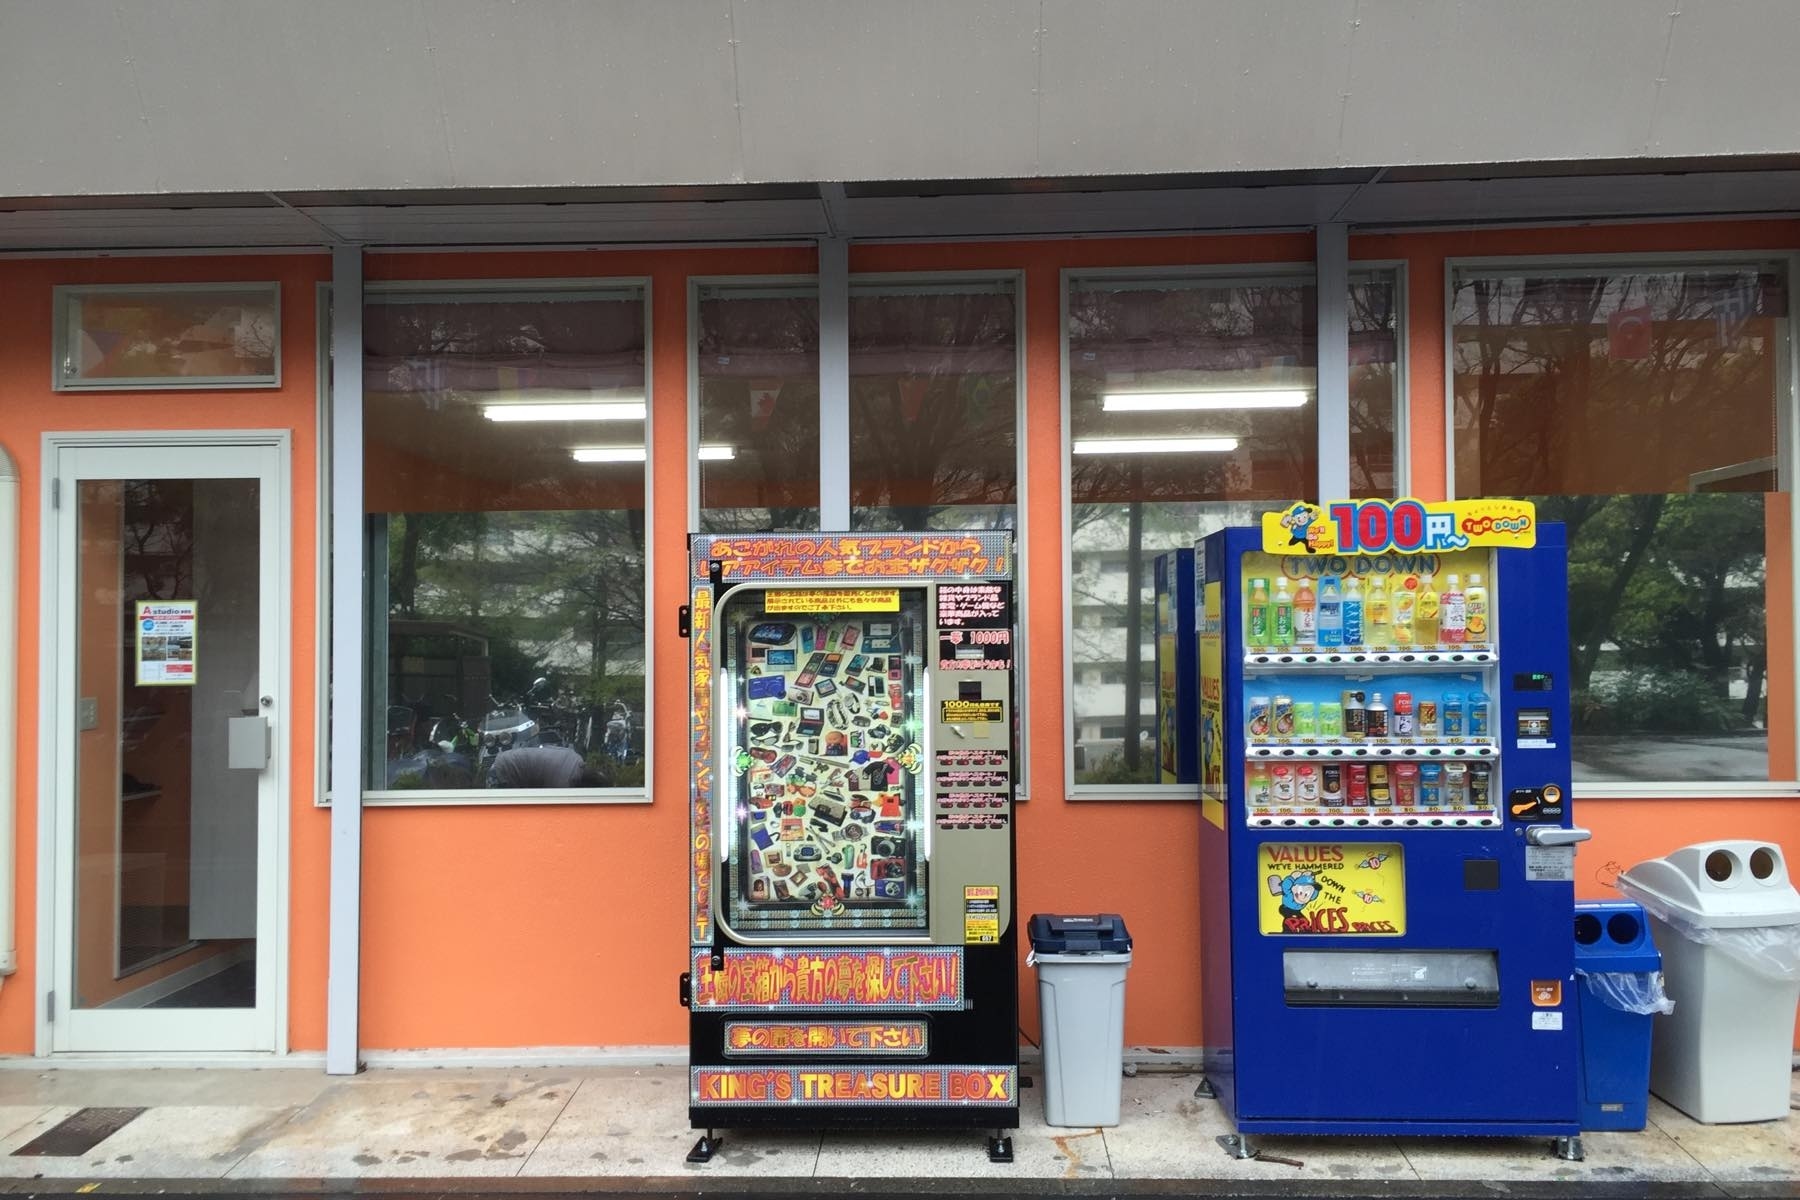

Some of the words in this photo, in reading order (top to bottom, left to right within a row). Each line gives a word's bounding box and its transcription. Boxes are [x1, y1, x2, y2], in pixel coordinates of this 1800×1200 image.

[1465, 520, 1491, 533] TWO
[1495, 519, 1527, 531] DOWN
[711, 537, 981, 557] あこがれの人気ブランドから
[1289, 555, 1347, 576] TWO
[1355, 554, 1436, 575] DOWN
[970, 631, 1010, 645] 1000円
[1266, 845, 1344, 863] VALUES
[1268, 863, 1293, 871] WE'VE
[1295, 863, 1344, 871] HAMMERED
[1320, 875, 1346, 893] DOWN
[1323, 892, 1342, 905] THE
[732, 1025, 922, 1049] 夢の扉を開いて下さい
[701, 1072, 792, 1100] KING'S
[799, 1072, 941, 1100] TREASURE
[949, 1072, 1008, 1100] BOX
